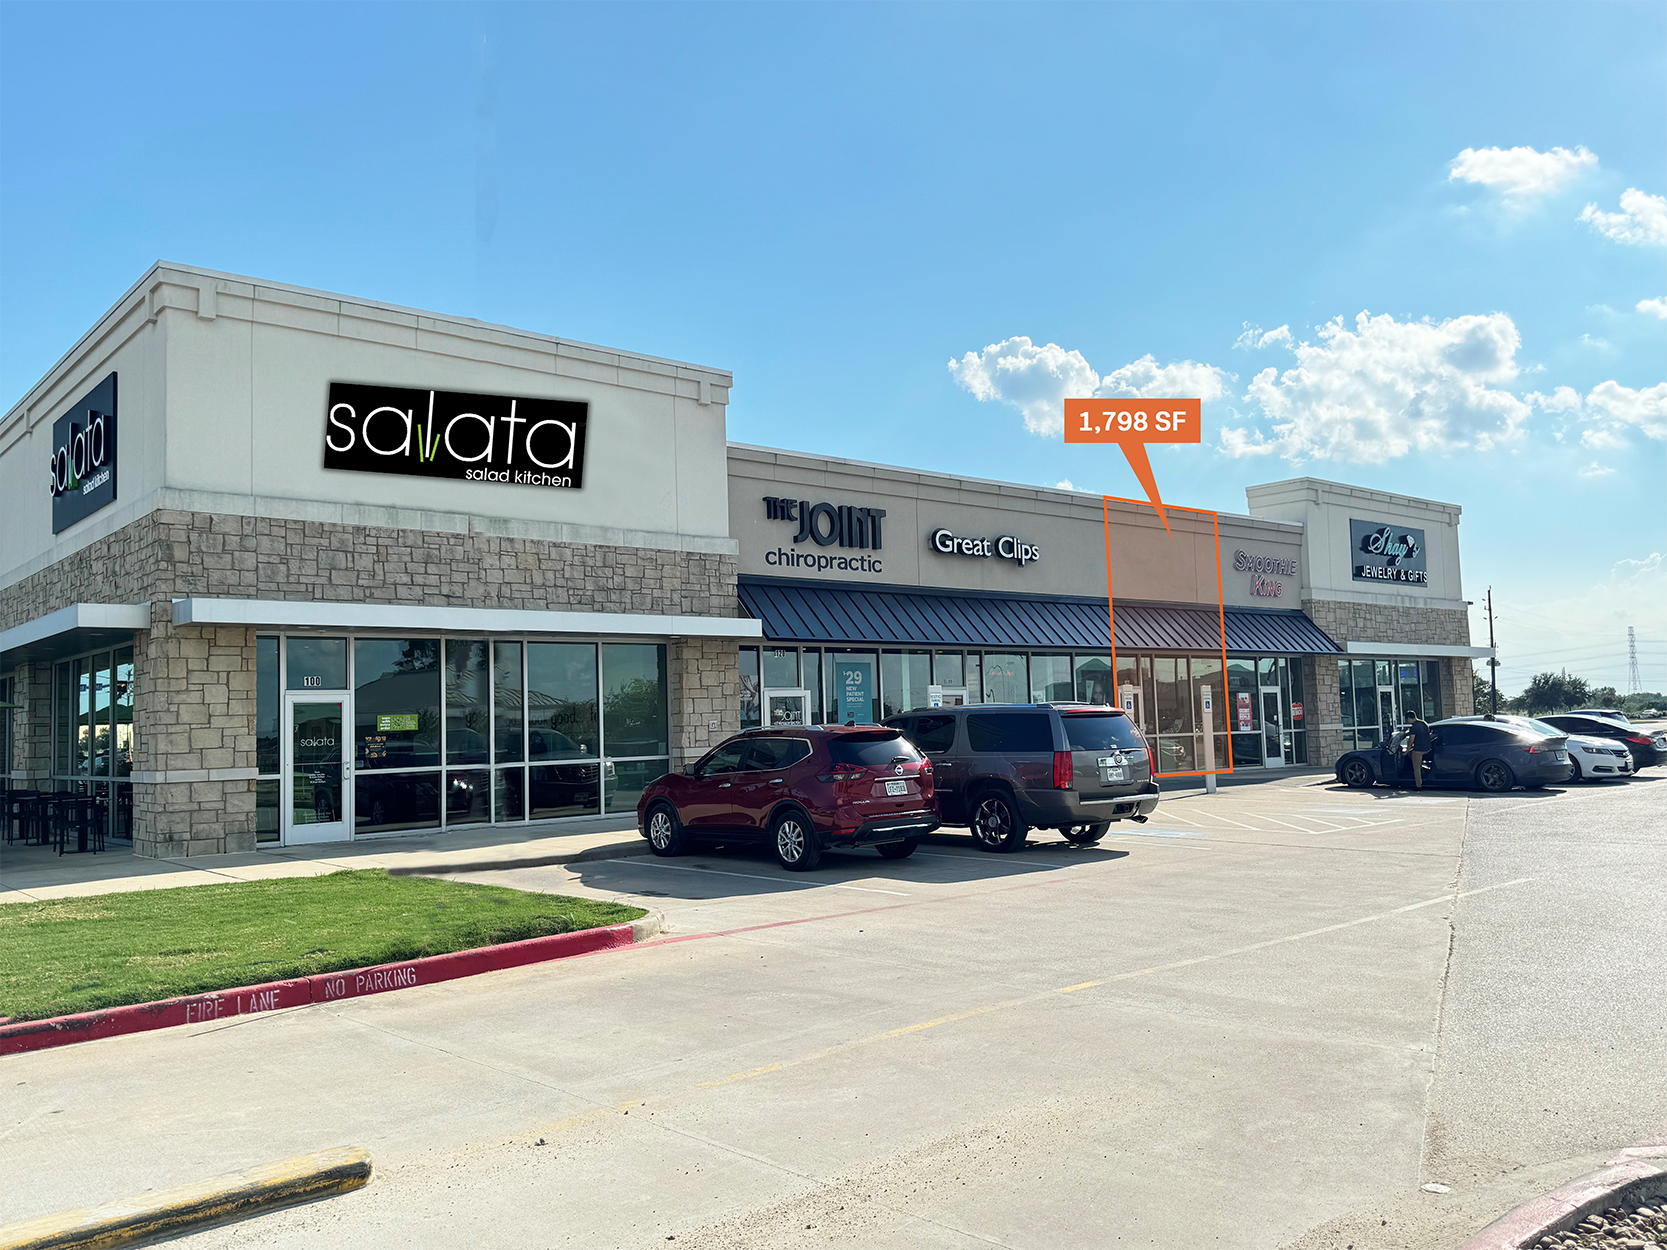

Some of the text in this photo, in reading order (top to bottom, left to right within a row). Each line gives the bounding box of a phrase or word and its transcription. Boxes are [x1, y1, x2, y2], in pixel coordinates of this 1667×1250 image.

[326, 390, 576, 470] salata
[49, 409, 105, 498] salata
[465, 467, 572, 488] salad kitchen
[762, 496, 886, 550] THE JOINT
[765, 548, 883, 574] chiropractic
[931, 528, 1041, 567] Great Clips
[1234, 549, 1298, 576] SMOOTHIE
[1361, 565, 1428, 583] JEWELRY & GIFTS
[304, 676, 321, 687] 100
[300, 736, 335, 747] salata
[325, 967, 417, 999] NO PARKING
[186, 989, 281, 1024] FIRE LANE
